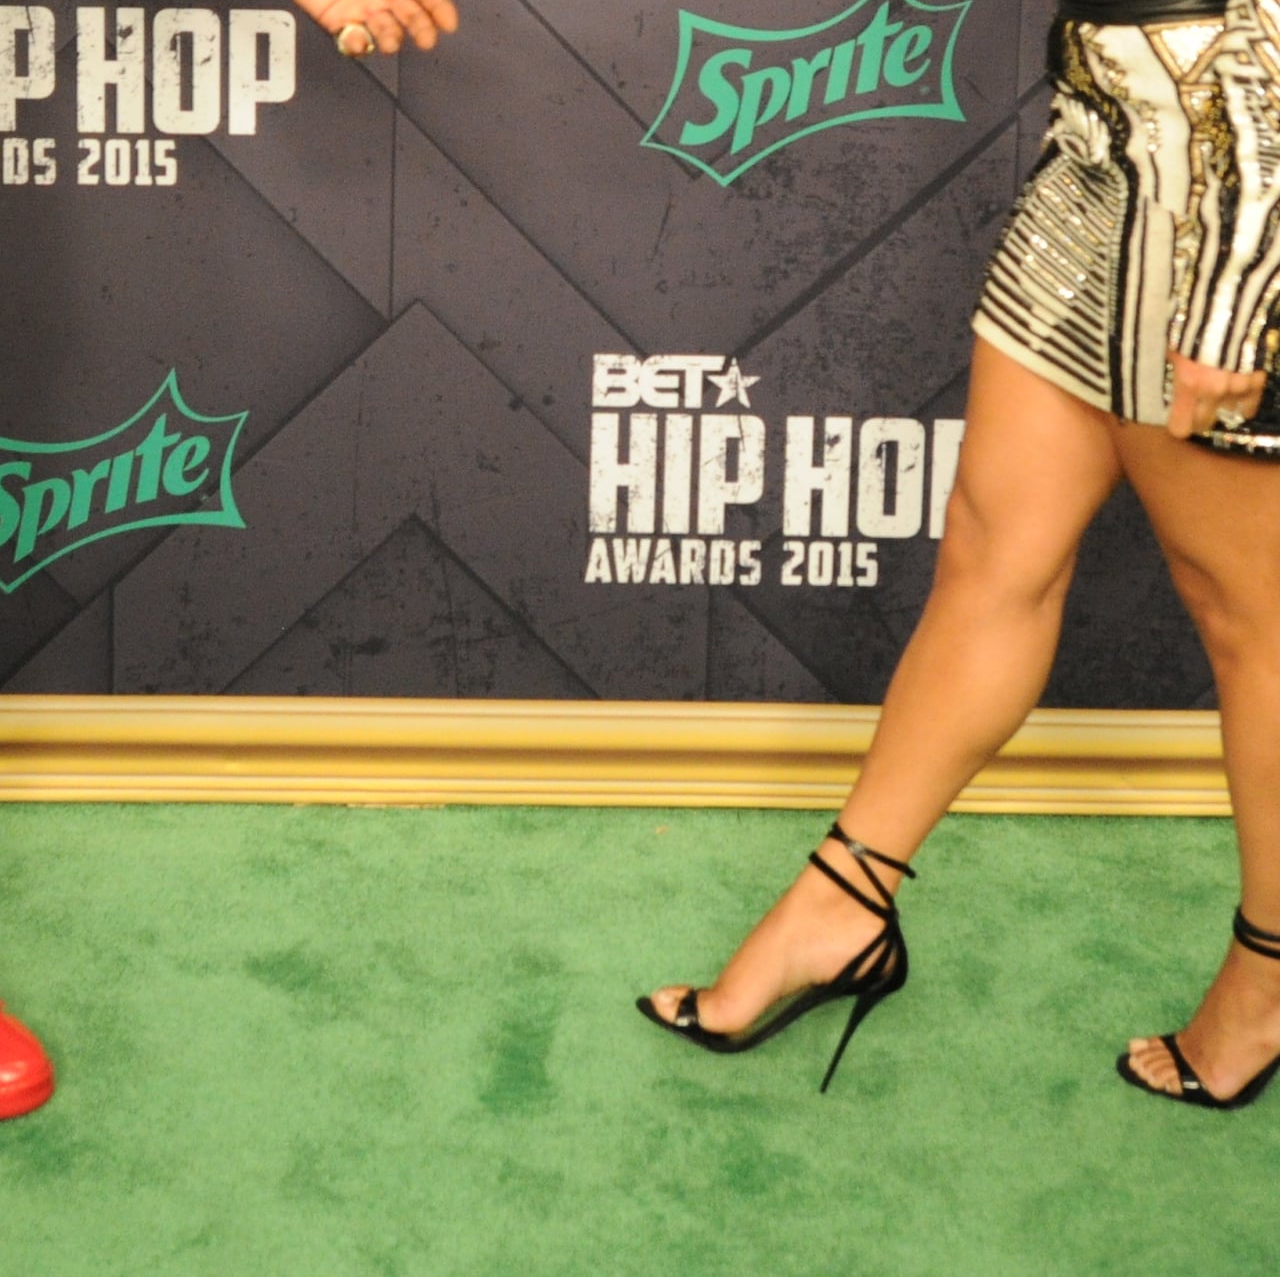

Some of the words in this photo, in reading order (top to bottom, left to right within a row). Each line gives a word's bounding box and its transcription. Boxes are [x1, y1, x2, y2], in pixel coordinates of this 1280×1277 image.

[76, 6, 296, 135] HOP
[678, 0, 935, 156] Sprite
[77, 138, 177, 186] 2015
[592, 354, 725, 408] BET
[589, 412, 765, 534] HIP
[584, 538, 762, 585] AWARDS
[780, 541, 878, 586] 2015
